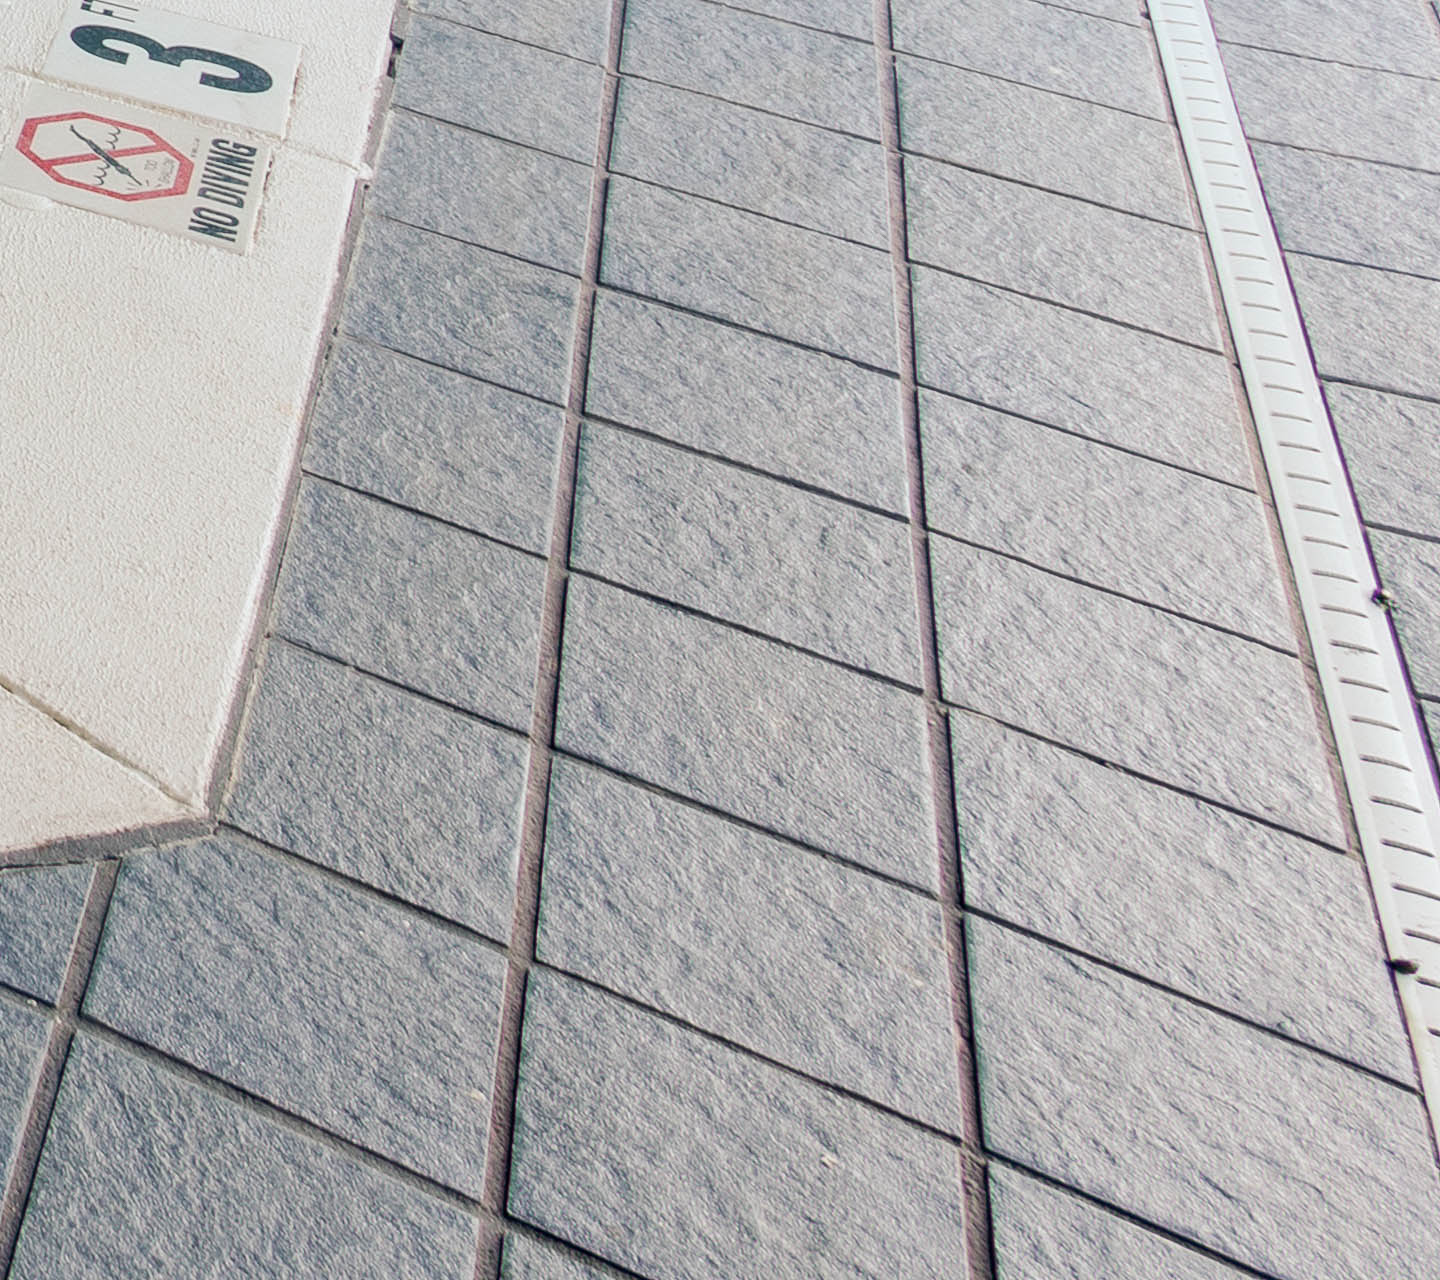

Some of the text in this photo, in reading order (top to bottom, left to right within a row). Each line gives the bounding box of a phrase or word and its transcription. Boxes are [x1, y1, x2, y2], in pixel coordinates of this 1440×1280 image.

[70, 24, 273, 94] 3
[188, 138, 258, 243] NO DIVING
